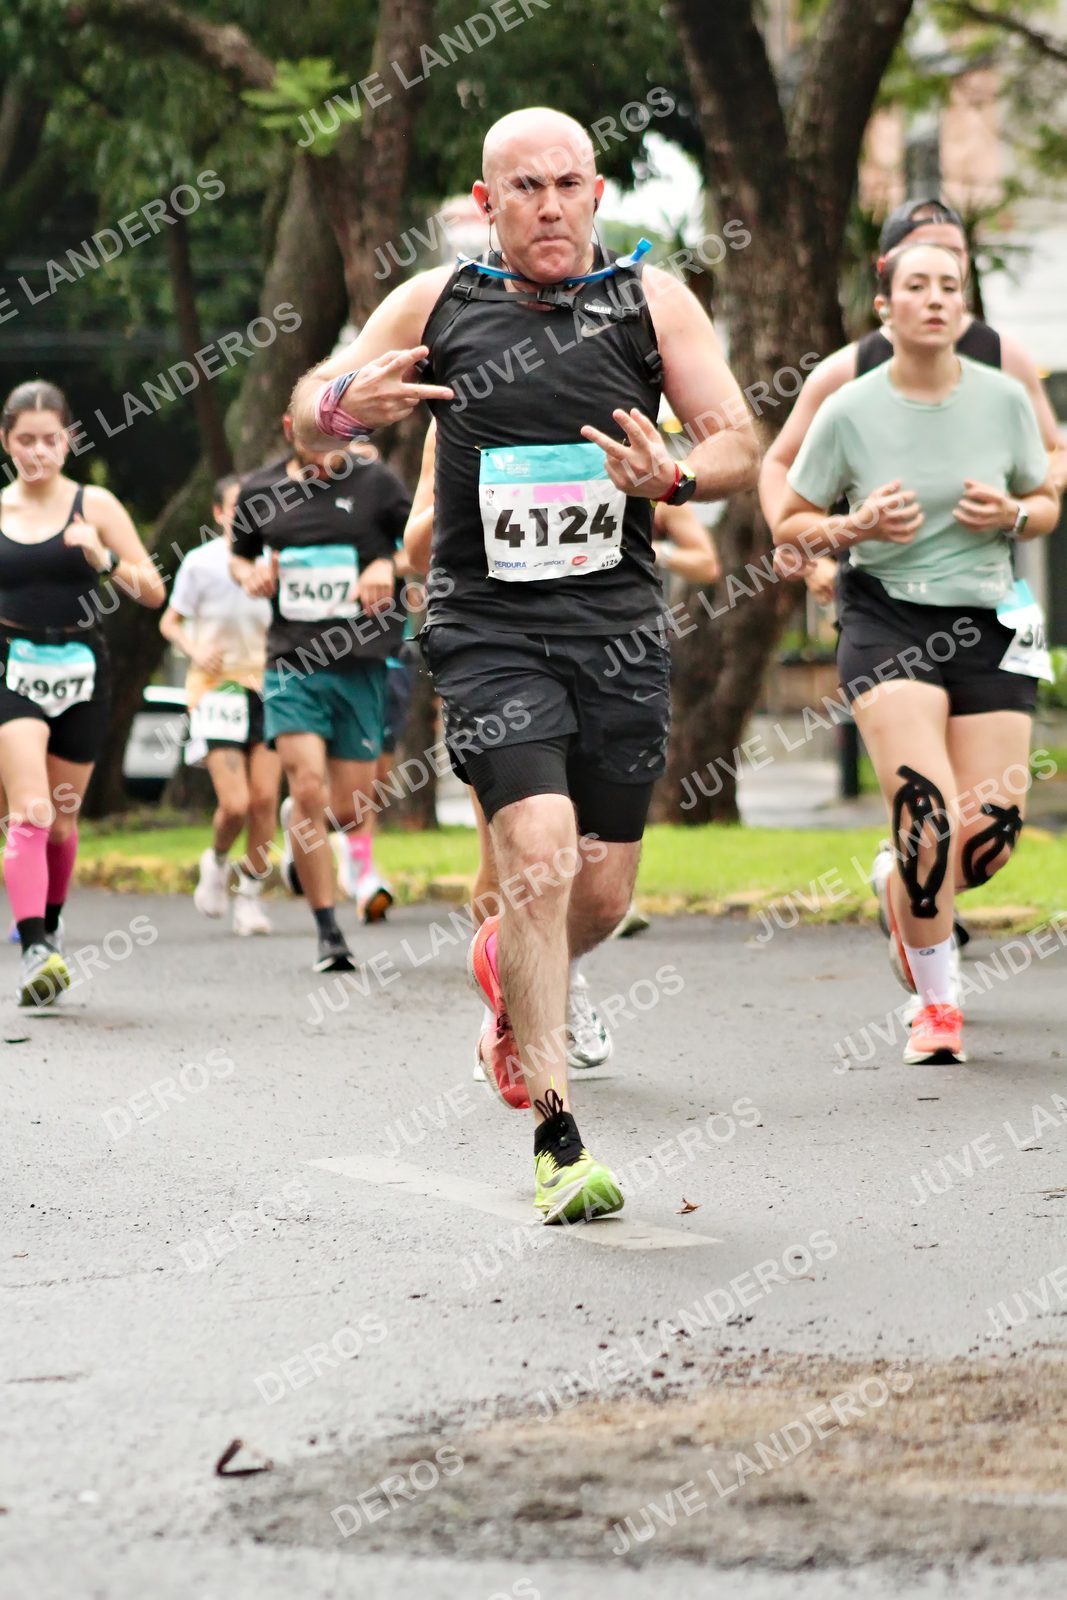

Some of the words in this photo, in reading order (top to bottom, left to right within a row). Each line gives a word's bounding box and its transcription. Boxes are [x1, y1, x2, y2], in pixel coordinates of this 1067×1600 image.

[495, 503, 617, 548] 4124
[494, 560, 527, 568] PERDURA
[288, 580, 350, 602] 5407
